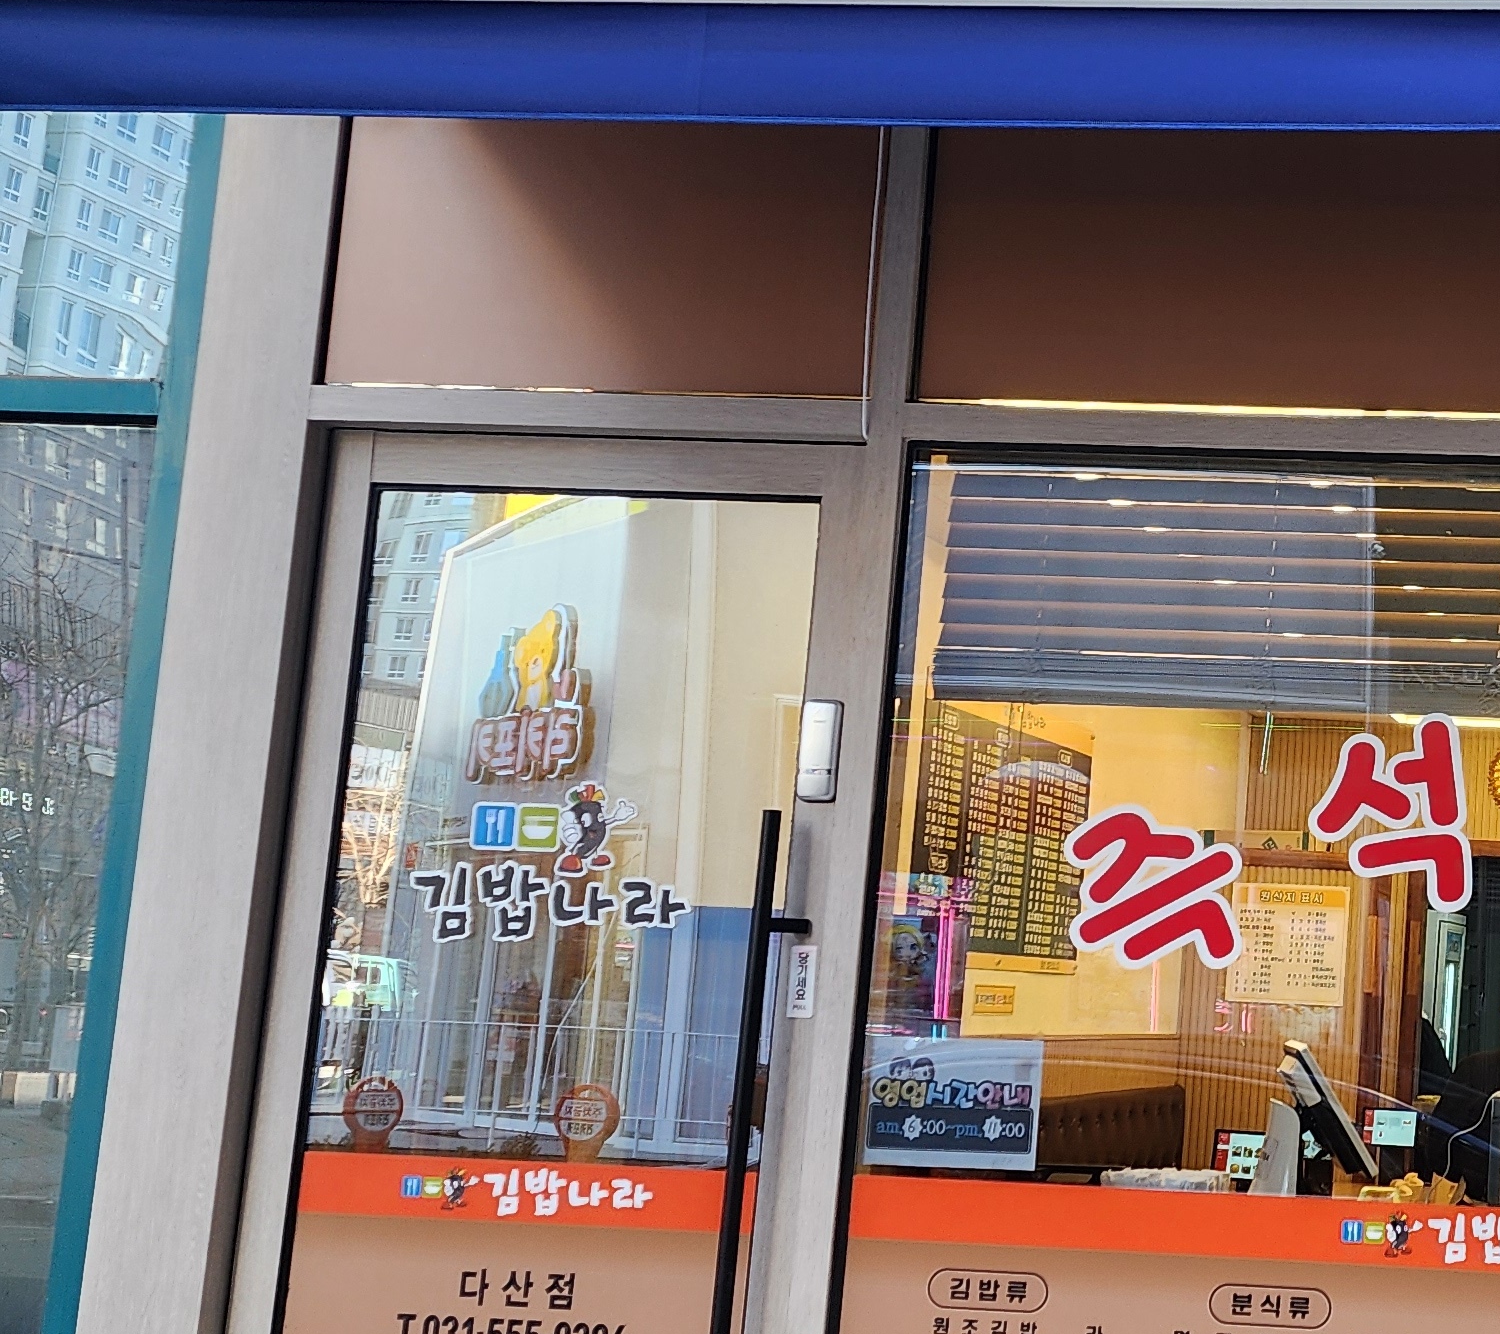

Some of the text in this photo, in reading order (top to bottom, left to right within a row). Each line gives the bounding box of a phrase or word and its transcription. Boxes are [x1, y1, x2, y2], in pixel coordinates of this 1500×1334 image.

[411, 861, 691, 941] 김밥나라
[795, 951, 809, 1000] 당기세요
[873, 1077, 1032, 1109] 영업시간안내
[484, 1168, 653, 1216] 김밥나라
[459, 1268, 576, 1310] 다산점
[950, 1278, 1027, 1303] 김밥류
[1231, 1293, 1309, 1319] 분식류
